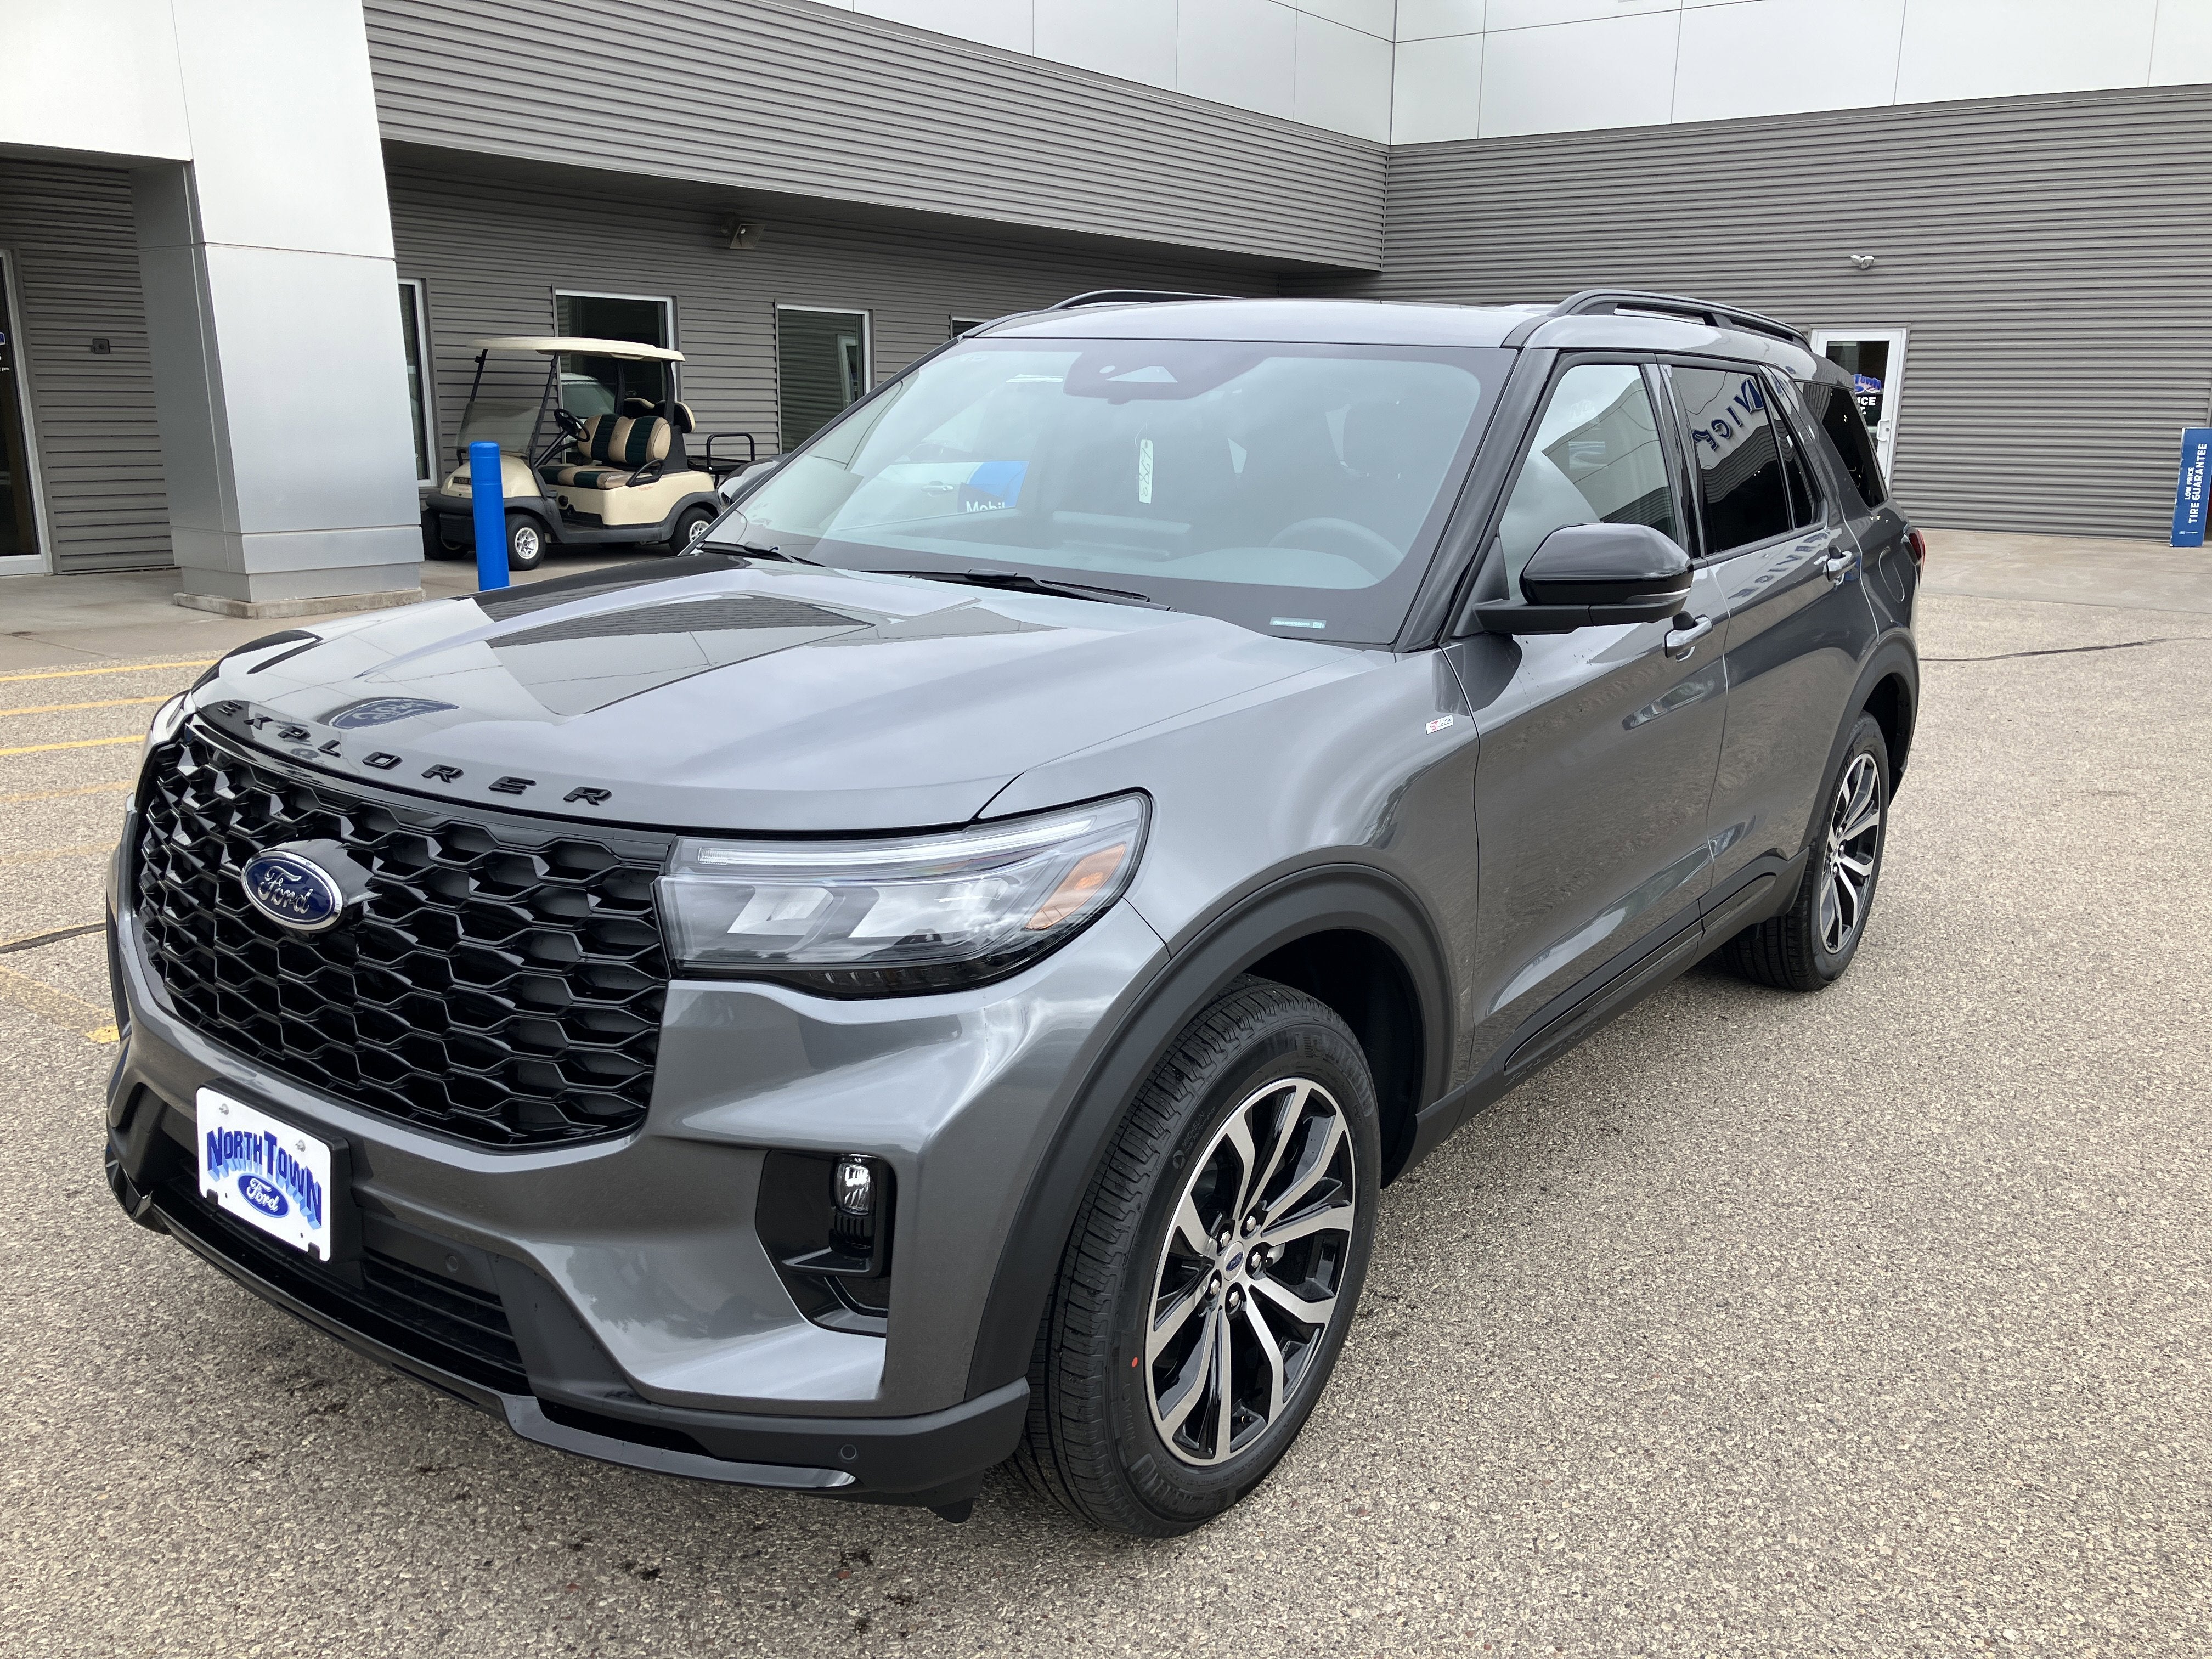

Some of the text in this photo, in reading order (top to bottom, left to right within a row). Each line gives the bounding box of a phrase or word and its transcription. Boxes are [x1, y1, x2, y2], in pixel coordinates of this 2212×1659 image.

[2188, 443, 2207, 524] TIRE GUARANTEE
[217, 700, 612, 805] EXPLORER
[257, 865, 314, 915] Ford
[246, 1177, 280, 1212] Ford
